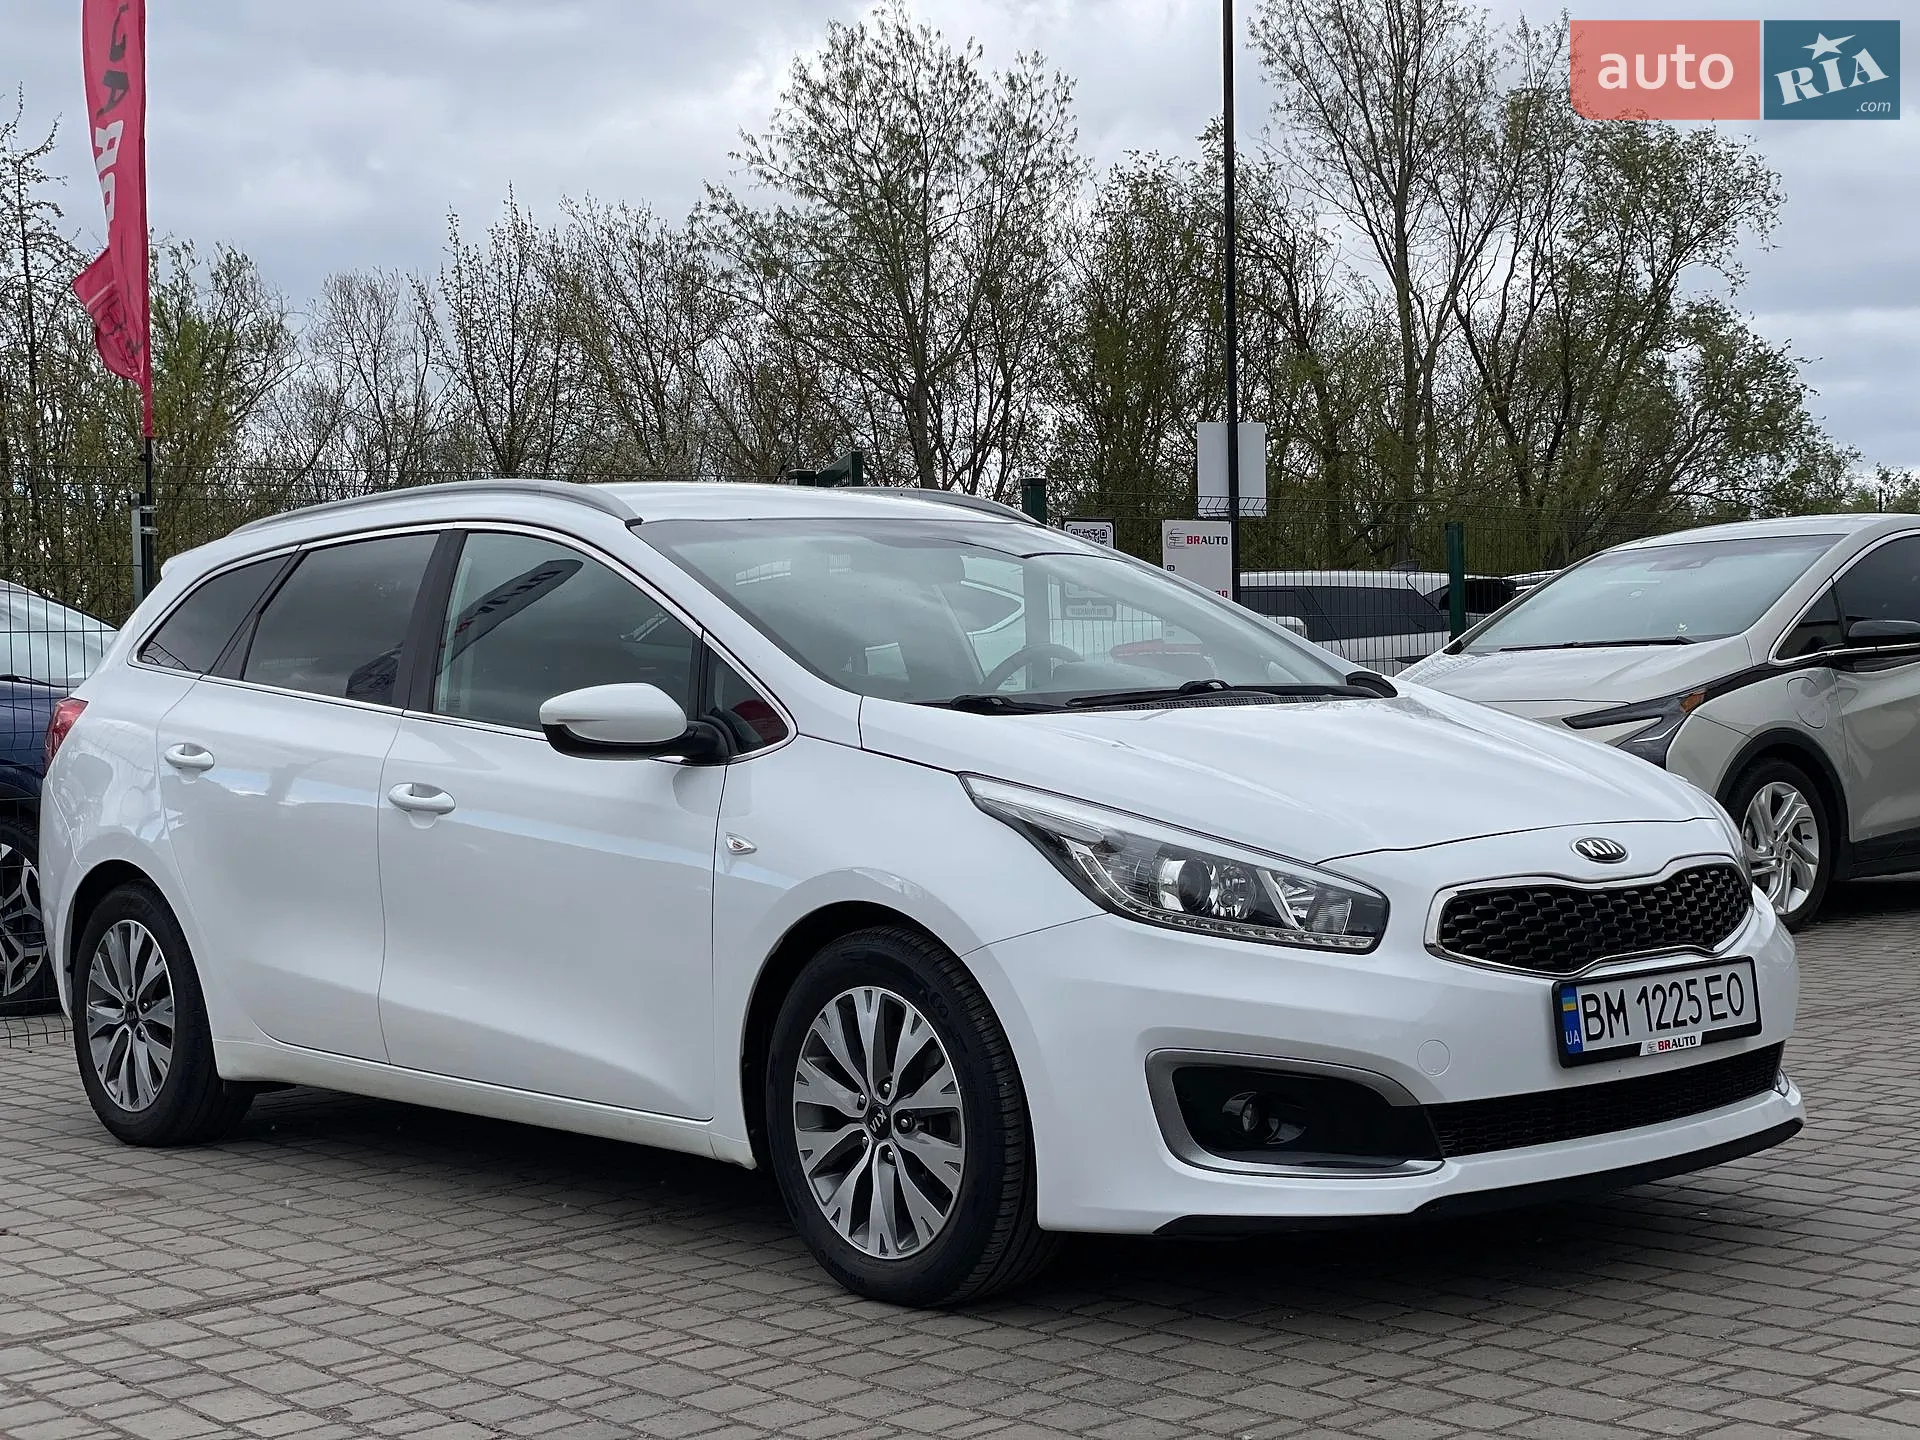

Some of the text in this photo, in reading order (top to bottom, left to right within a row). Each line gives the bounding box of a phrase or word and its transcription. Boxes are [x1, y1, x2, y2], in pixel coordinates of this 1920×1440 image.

[1186, 535, 1228, 545] BRAUTO
[1578, 839, 1625, 857] KIA
[1580, 971, 1745, 1042] BM 1225 EO
[1565, 1029, 1581, 1045] UA
[1657, 1035, 1697, 1051] BRAUTO
[869, 1107, 887, 1133] KIA
